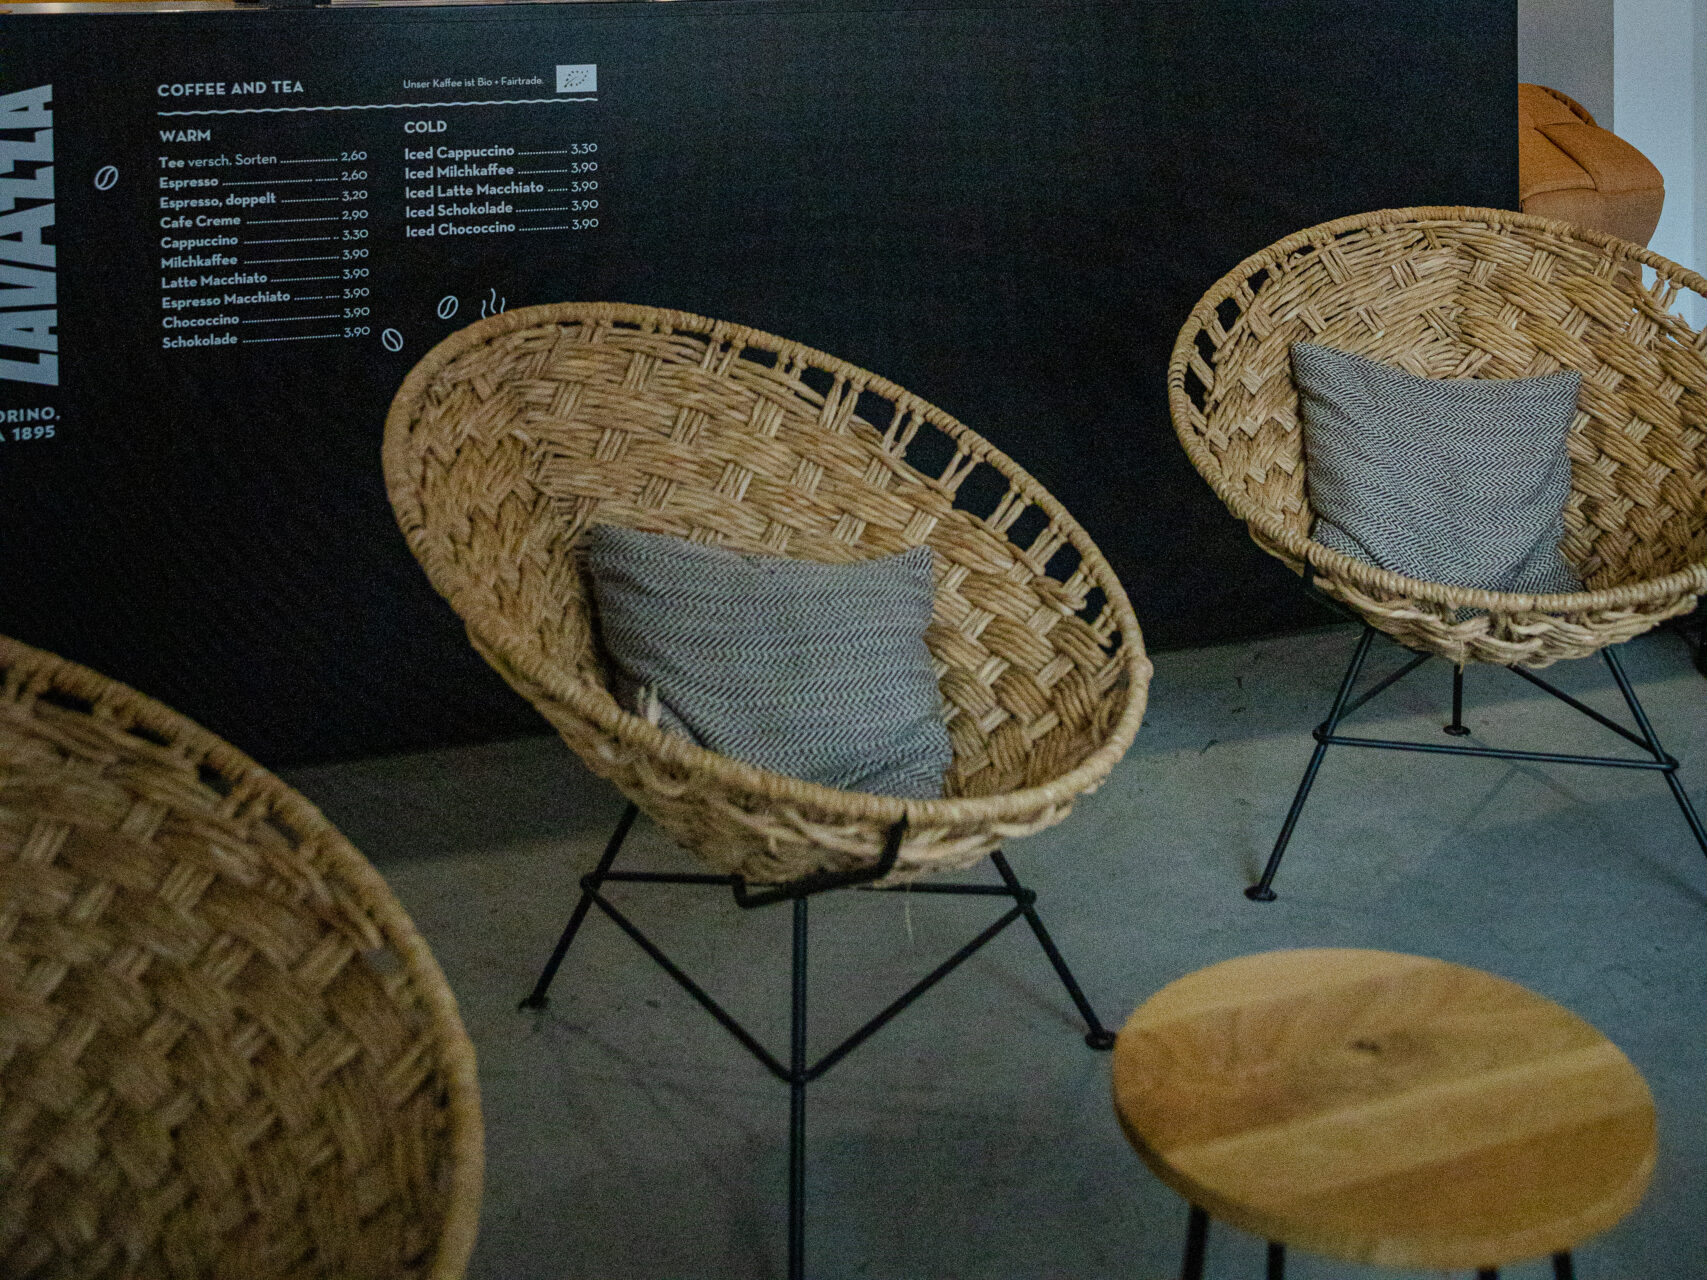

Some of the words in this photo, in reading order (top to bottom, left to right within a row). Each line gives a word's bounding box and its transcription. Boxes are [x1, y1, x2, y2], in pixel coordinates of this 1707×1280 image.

[157, 82, 226, 97] COFFEE
[231, 81, 267, 95] AND
[272, 80, 304, 93] TEA
[403, 80, 430, 89] Unser
[433, 78, 462, 88] Kaffee
[464, 79, 475, 87] ist
[477, 77, 493, 87] Bio
[159, 129, 211, 143] WARM
[404, 120, 447, 133] COLD
[159, 156, 185, 169] Tee
[188, 154, 232, 168] versch.
[235, 153, 277, 166] Sorten
[341, 151, 367, 163] 2,60
[404, 146, 434, 160] Iced
[436, 145, 515, 161] Cappuccino
[570, 143, 598, 155] 3,30
[159, 177, 219, 191] Espresso
[341, 170, 368, 182] 2,60
[405, 166, 434, 180] Iced
[437, 163, 514, 178] Milchkaffee
[571, 162, 598, 174] 3,90
[405, 185, 434, 199] Iced
[438, 184, 473, 197] Latte
[477, 181, 544, 196] Macchiato
[571, 181, 598, 193] 3,90
[160, 196, 223, 211] Espresso,
[225, 192, 276, 209] doppelt
[341, 190, 368, 202] 3,20
[406, 204, 435, 218] Iced
[438, 201, 513, 217] Schokolade
[572, 200, 599, 212] 3,90
[160, 216, 193, 229] Cafe
[196, 215, 241, 228] Creme
[342, 209, 369, 221] 2,90
[406, 223, 435, 238] Iced
[438, 221, 516, 236] Chococcino
[572, 218, 599, 231] 3,90
[160, 235, 239, 251] Cappuccino
[342, 229, 369, 241] 3,30
[161, 253, 238, 269] Milchkaffee
[342, 248, 369, 261] 3,90
[161, 277, 197, 289] Latte
[200, 272, 268, 287] Macchiato
[343, 268, 370, 280] 3,90
[161, 297, 221, 311] Espresso
[224, 290, 291, 305] Macchiato
[343, 287, 370, 300] 3,90
[162, 314, 240, 329] Chococcino
[343, 307, 370, 319] 3,90
[162, 333, 238, 349] Schokolade
[344, 326, 371, 339] 3,90
[12, 425, 55, 441] 1895
